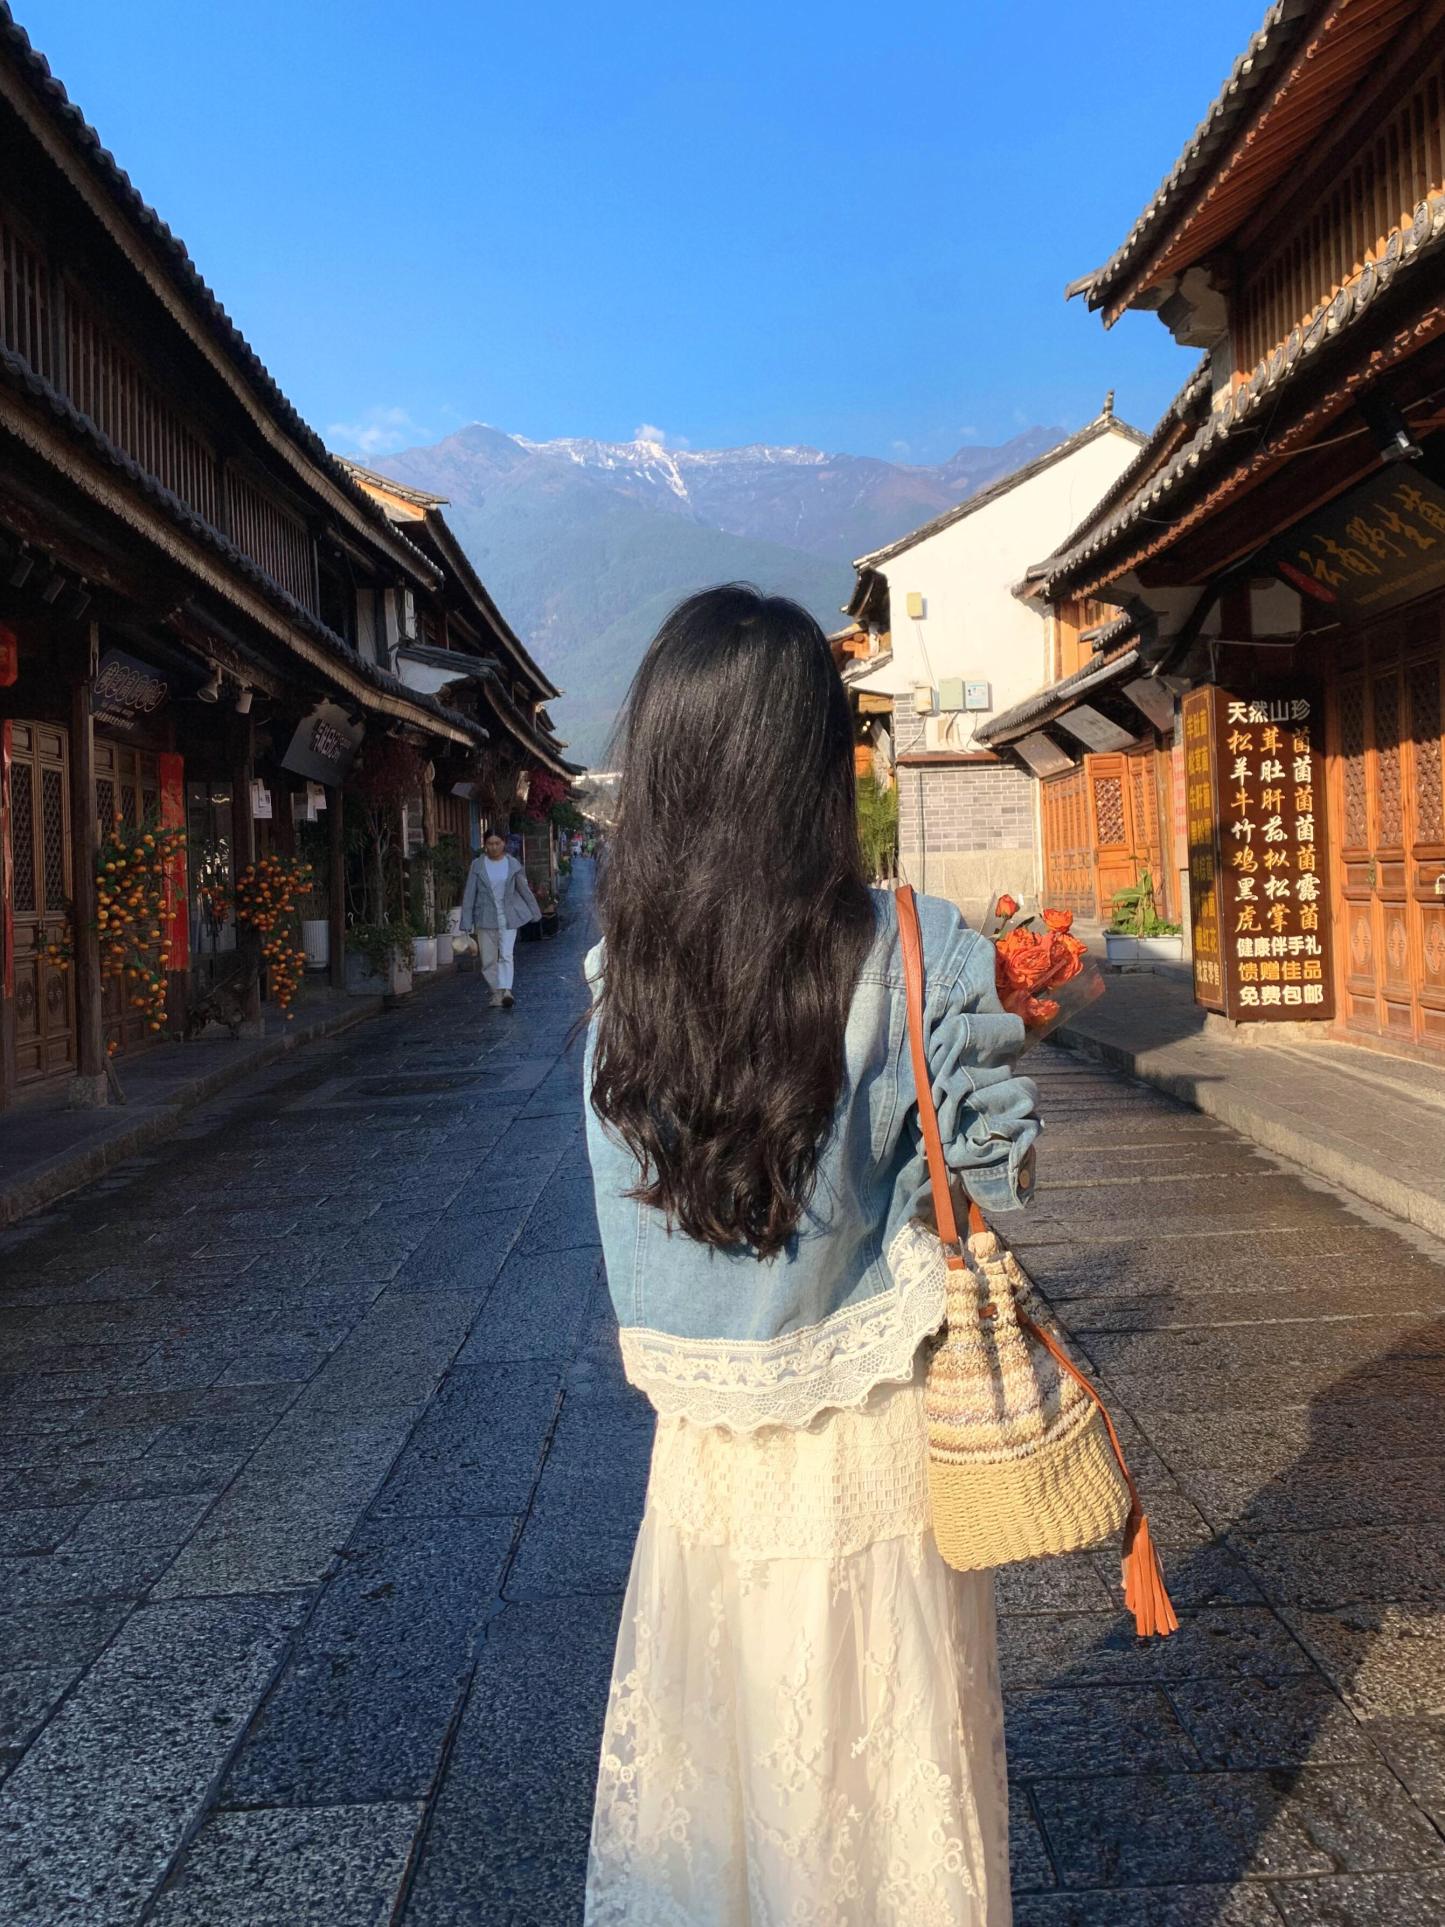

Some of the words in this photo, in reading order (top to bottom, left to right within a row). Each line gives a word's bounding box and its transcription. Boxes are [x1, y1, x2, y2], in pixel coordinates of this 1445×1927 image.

[1186, 709, 1208, 741] 羊肚菌
[1228, 698, 1311, 724] 天然山珍
[1227, 726, 1311, 756] 松茸菌
[1230, 755, 1312, 786] 羊肚菌
[1231, 785, 1313, 816] 牛肝菌
[1231, 814, 1315, 844] 竹荪菌
[1232, 844, 1316, 873] 鸡枞菌
[1234, 873, 1321, 902] 黑松露
[1235, 902, 1319, 932] 虎掌菌
[1236, 935, 1322, 958] 健康伴手礼
[1238, 960, 1322, 982] 馈赠佳品
[1239, 984, 1324, 1006] 免费包邮
